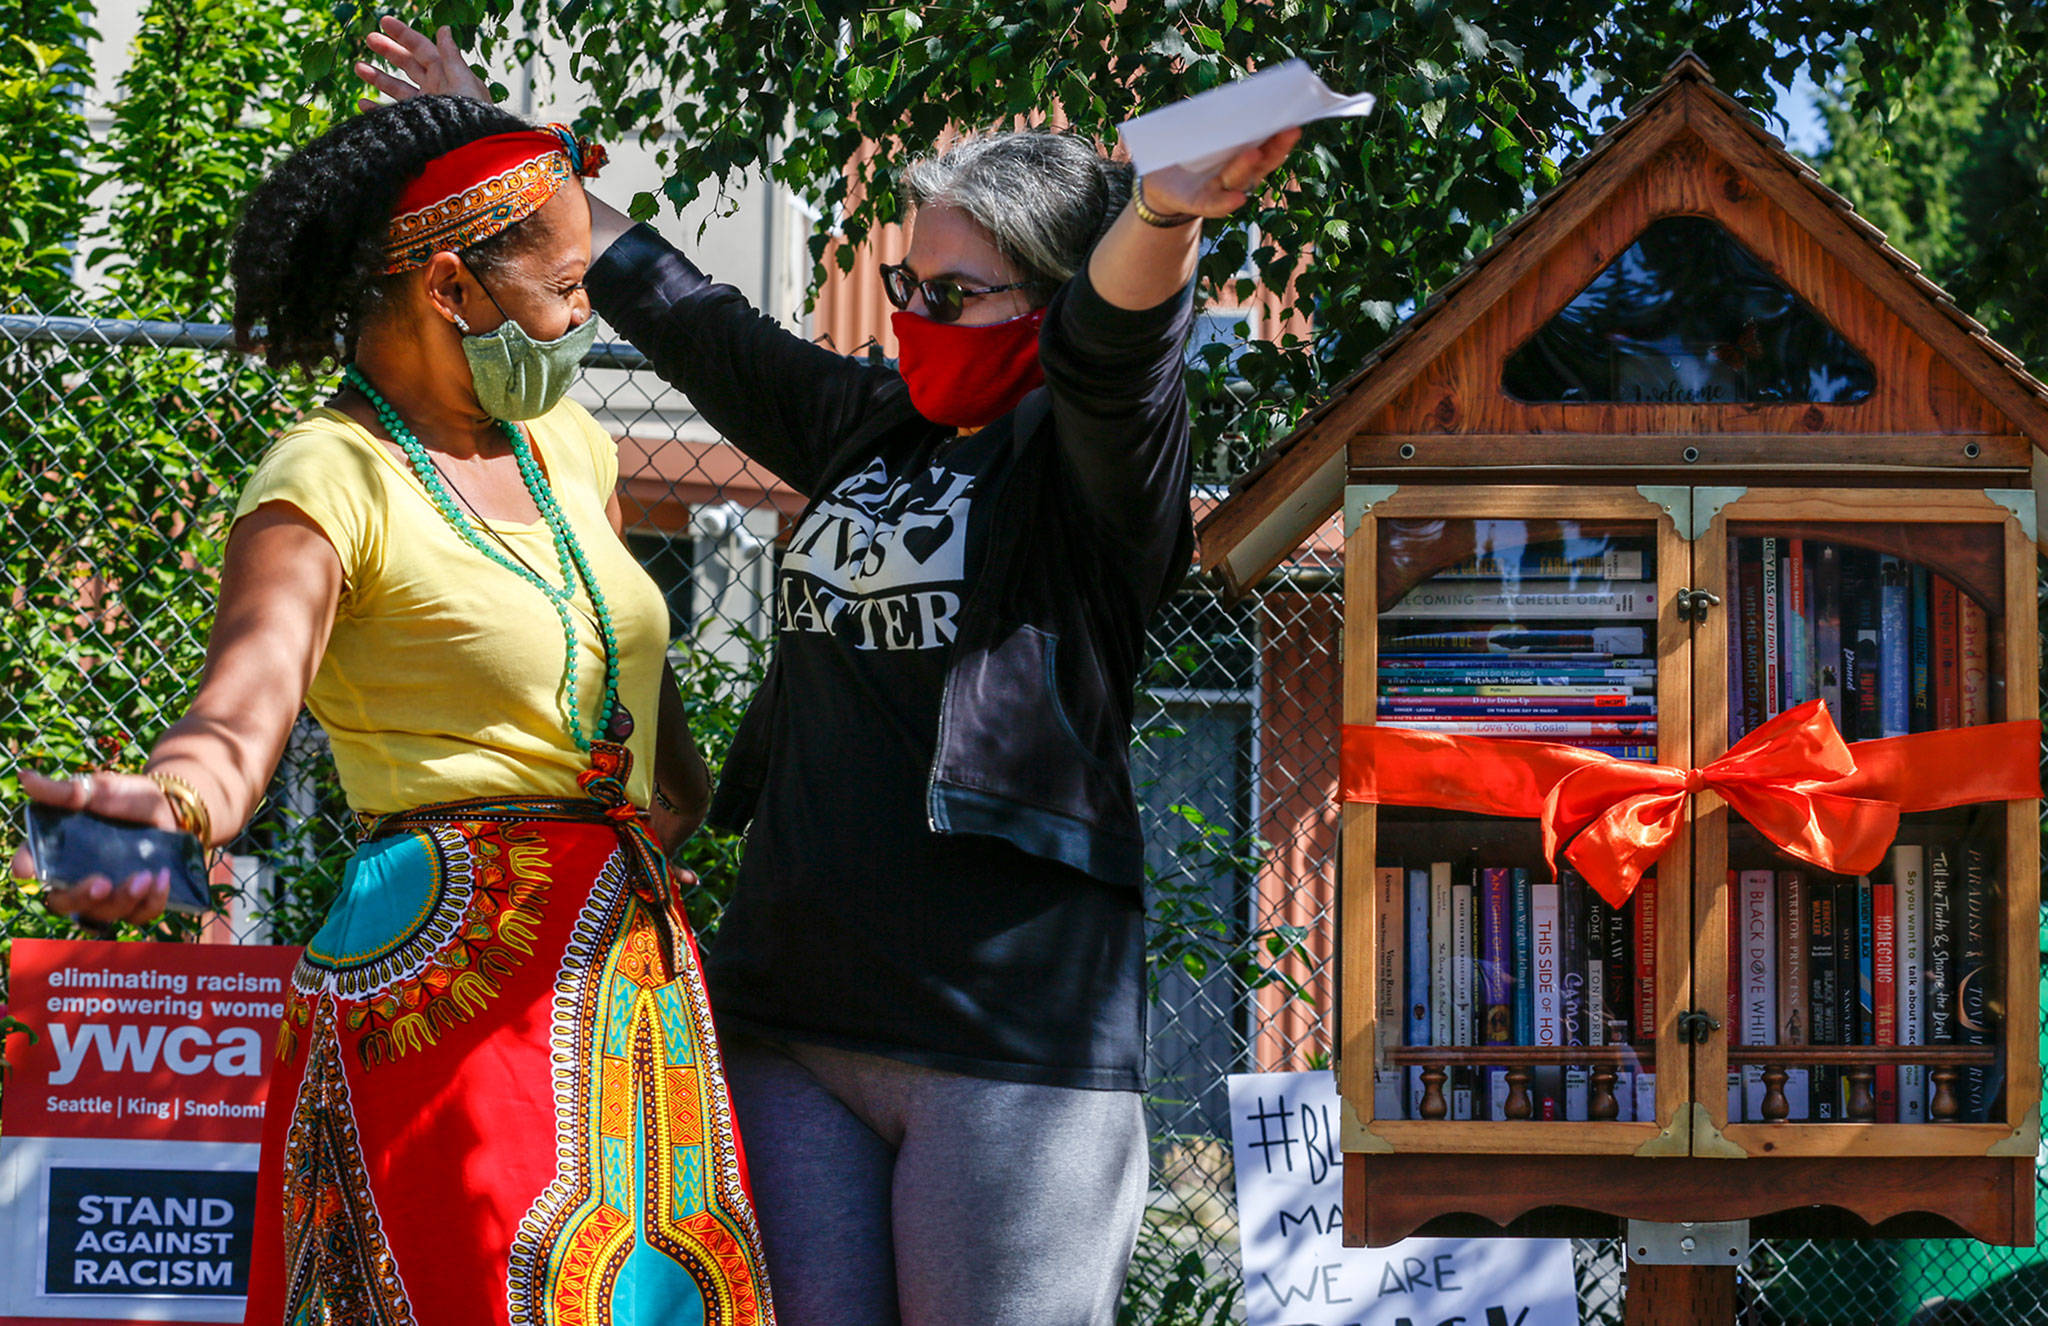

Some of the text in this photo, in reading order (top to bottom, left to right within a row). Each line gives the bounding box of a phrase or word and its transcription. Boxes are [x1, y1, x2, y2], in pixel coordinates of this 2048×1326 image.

[1766, 569, 1776, 594] DIAS
[1745, 586, 1756, 617] WITH
[1766, 595, 1777, 620] GETS
[1745, 620, 1757, 641] THE
[1767, 621, 1777, 633] IT
[1965, 625, 1983, 659] and
[1746, 643, 1758, 683] MIGHT
[1767, 633, 1778, 662] DONE
[1843, 647, 1857, 693] Pinned
[1747, 686, 1758, 702] OF
[1477, 722, 1569, 735] Love You, Rosie!
[1491, 874, 1501, 891] AN
[1907, 870, 1918, 886] So
[1517, 878, 1527, 911] Marian
[1905, 888, 1916, 911] you
[1967, 849, 1985, 943] PARADISE
[1516, 914, 1527, 947] Wright
[1591, 905, 1600, 942] HOME
[1642, 892, 1654, 965] RESURRECTION
[1750, 890, 1766, 941] BLACK
[1812, 899, 1822, 935] WALKER
[1822, 899, 1833, 937] REBECCA
[1907, 914, 1917, 944] want
[1538, 920, 1552, 956] THIS
[1788, 879, 1801, 1005] WARRIOR PRINCESS
[1876, 914, 1892, 984] HOMEGOING
[1908, 947, 1917, 960] to
[1932, 852, 1953, 1039] Tell the Truth & Shame the Devil
[48, 967, 282, 993] eliminating racism
[1517, 949, 1528, 990] Edelman
[1538, 959, 1553, 994] SIDE
[1591, 968, 1601, 998] TONI
[1750, 947, 1766, 993] DOVE
[1908, 965, 1918, 986] talk
[46, 995, 284, 1019] empowering wome
[1542, 997, 1551, 1013] OF
[1641, 996, 1653, 1033] TURNER
[1879, 1003, 1891, 1025] YAA
[1908, 989, 1918, 1022] about
[47, 1022, 262, 1086] ywca
[46, 1096, 266, 1120] Seattle King Snohomi
[77, 1195, 235, 1227] STAND
[75, 1230, 234, 1255] AGAINST
[73, 1258, 233, 1288] RACISM
[1262, 1254, 1463, 1308] WE ARE
